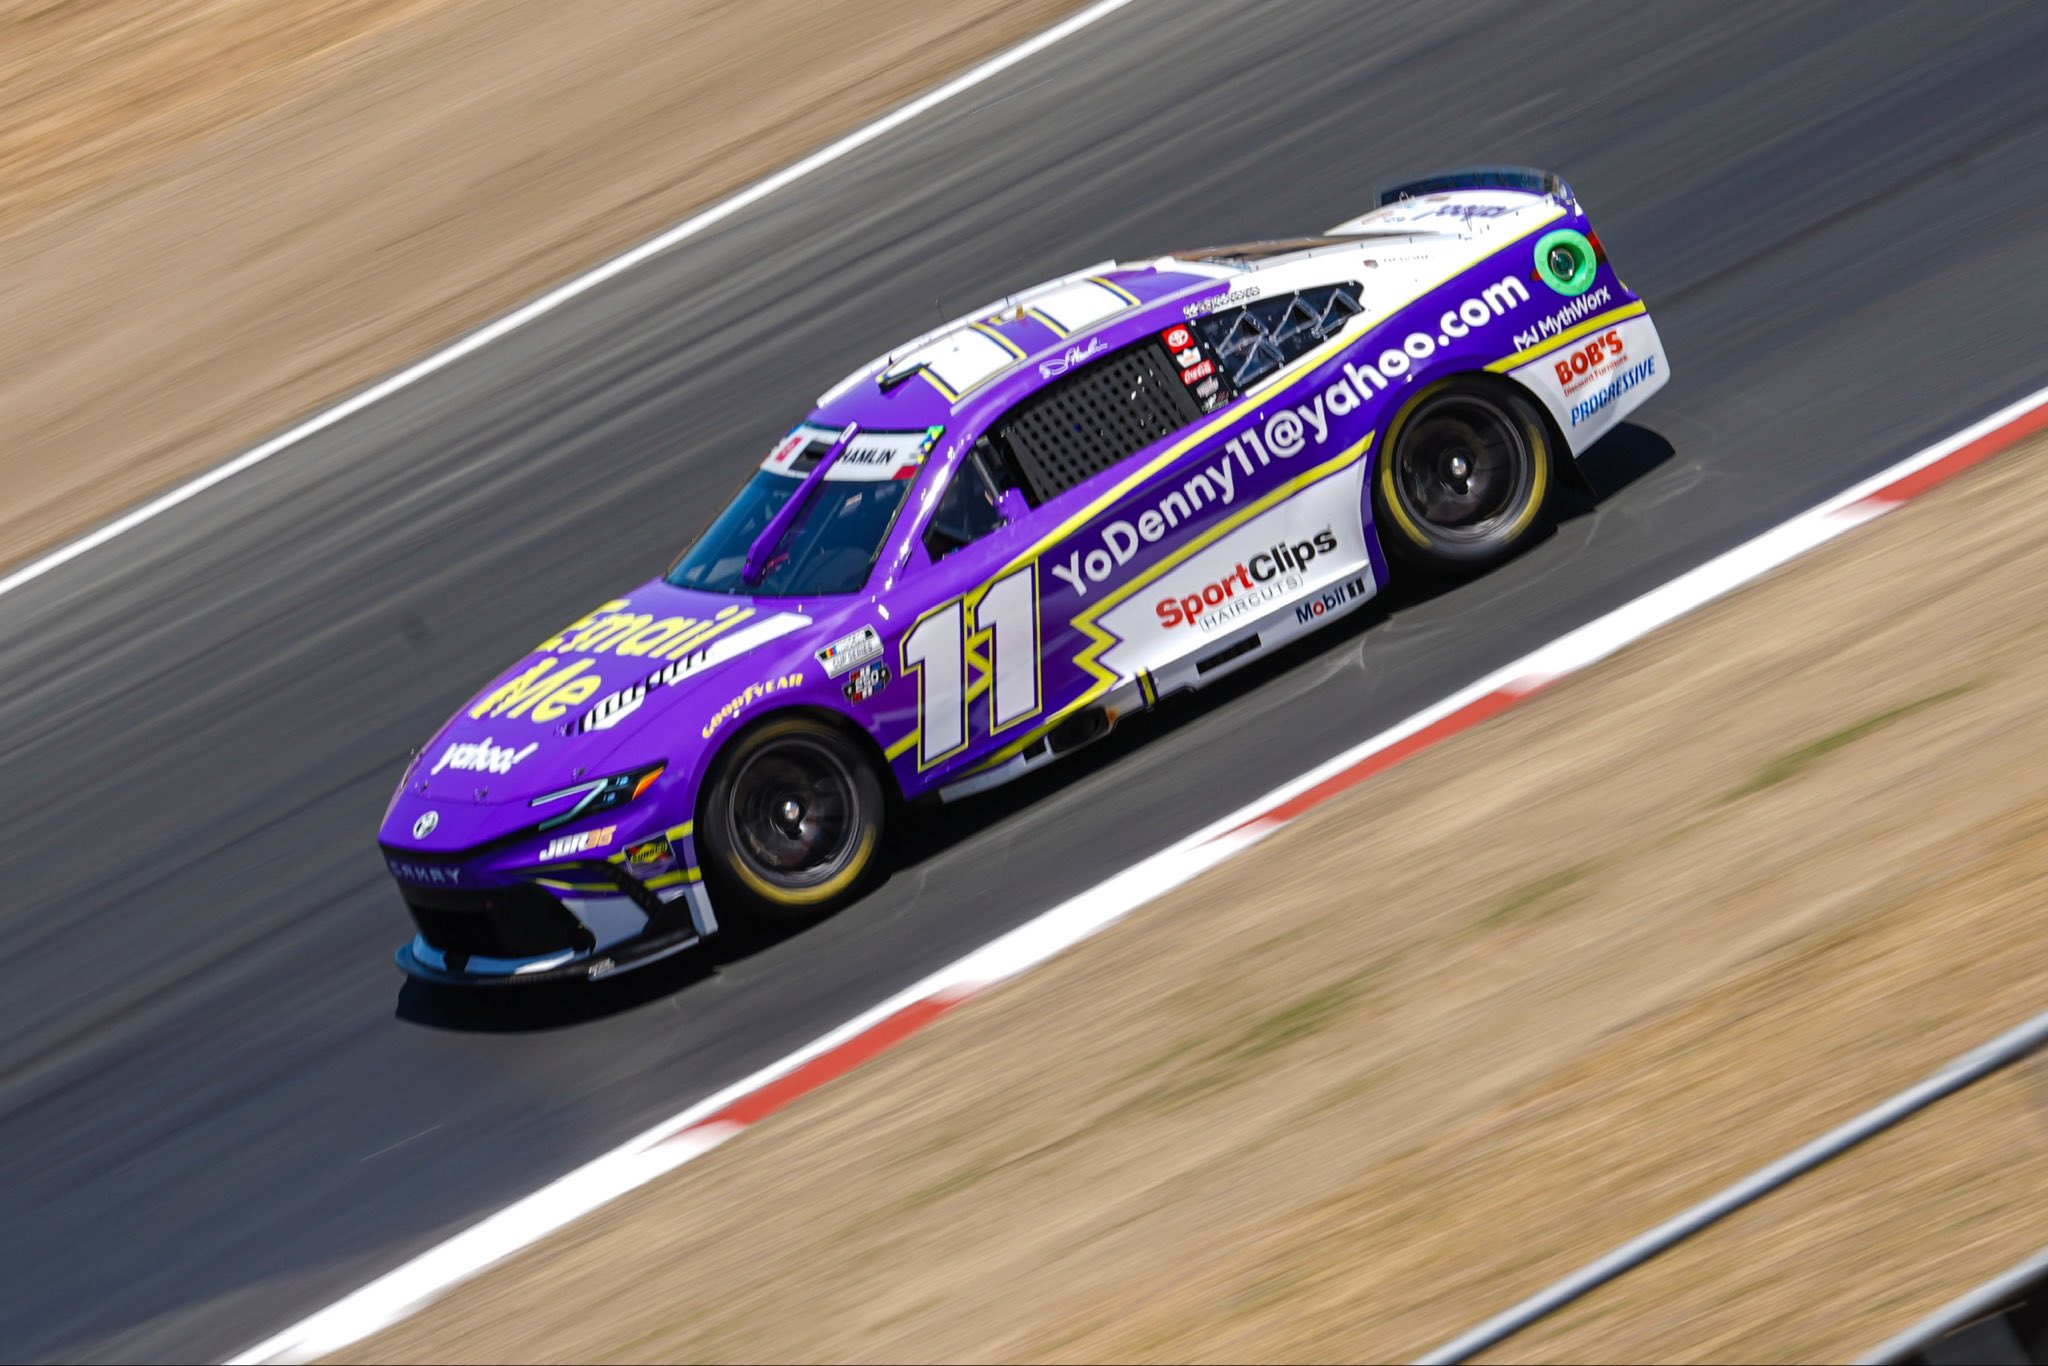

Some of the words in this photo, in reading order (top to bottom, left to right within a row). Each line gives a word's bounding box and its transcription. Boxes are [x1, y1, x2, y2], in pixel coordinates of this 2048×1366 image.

[1538, 285, 1612, 338] MythWorx
[1554, 329, 1624, 386] BOB'S
[1571, 355, 1656, 428] PROGRESSIVE
[1052, 275, 1530, 597] YoDenny11@yahoo.com
[1156, 530, 1338, 629] SportClips
[1296, 588, 1347, 624] Mobil
[1347, 577, 1366, 598] 1
[533, 599, 757, 661] Email
[469, 657, 602, 723] Me
[900, 558, 1042, 773] 11
[702, 673, 804, 739] GOODYEAR
[431, 737, 539, 776] yahoo!
